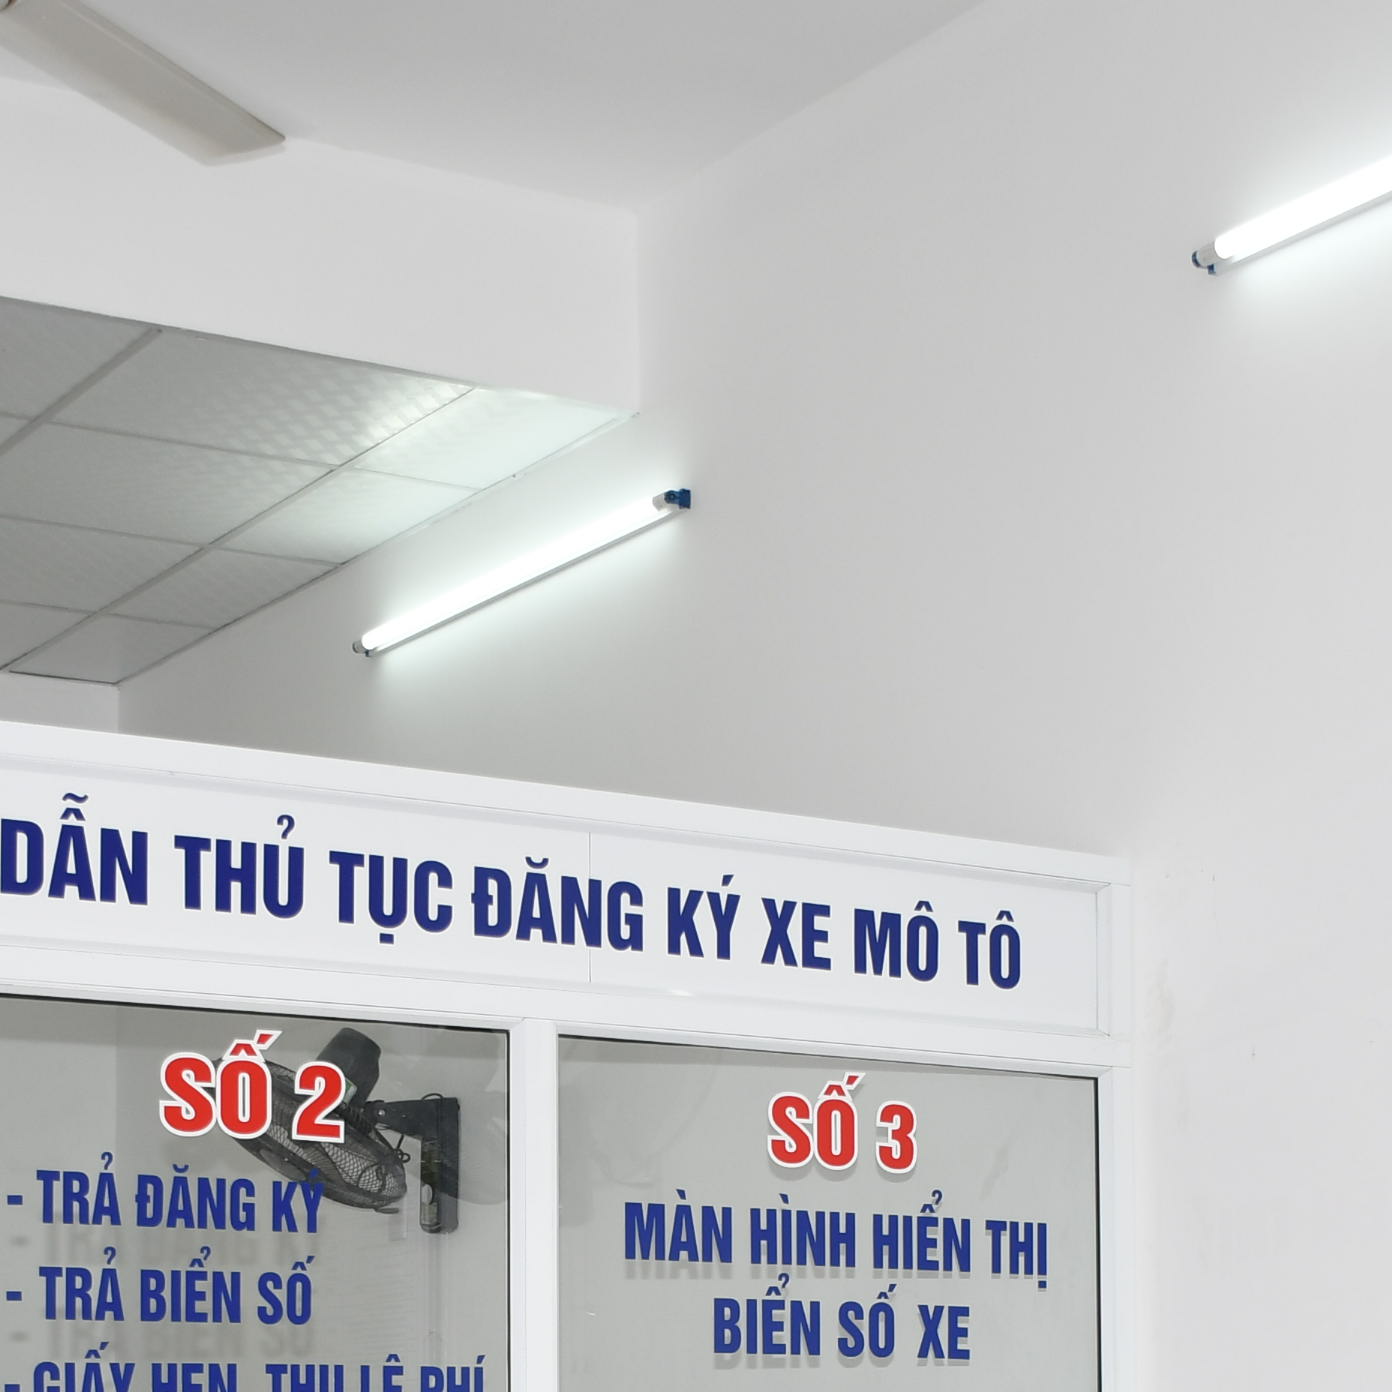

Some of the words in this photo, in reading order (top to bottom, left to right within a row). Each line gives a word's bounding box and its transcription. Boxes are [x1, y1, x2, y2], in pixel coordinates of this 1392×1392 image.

[0, 793, 148, 905] DẪN
[175, 815, 304, 918] THỦ
[330, 851, 453, 943] TỤC
[472, 858, 644, 950] ĐĂNG
[668, 875, 740, 958] KÝ
[763, 898, 832, 969] XE
[855, 901, 940, 980] MÔ
[959, 910, 1021, 988] TÔ
[160, 1029, 284, 1140] SỐ
[292, 1062, 347, 1143] 2
[768, 1072, 866, 1170] SỐ
[875, 1100, 918, 1174] 3
[33, 1148, 123, 1230] TRẢ
[133, 1160, 258, 1236] ĐĂNG
[270, 1165, 328, 1238] KÝ
[625, 1190, 733, 1263] MÀN
[751, 1194, 857, 1267] HÌNH
[873, 1190, 972, 1273] HIỂN
[986, 1220, 1049, 1289] THỊ
[36, 1243, 126, 1324] TRẢ
[138, 1243, 244, 1326] BIỂN
[255, 1253, 317, 1327] SỐ
[714, 1273, 821, 1356] BIỂN
[838, 1284, 895, 1358] SỐ
[916, 1304, 971, 1360] XE
